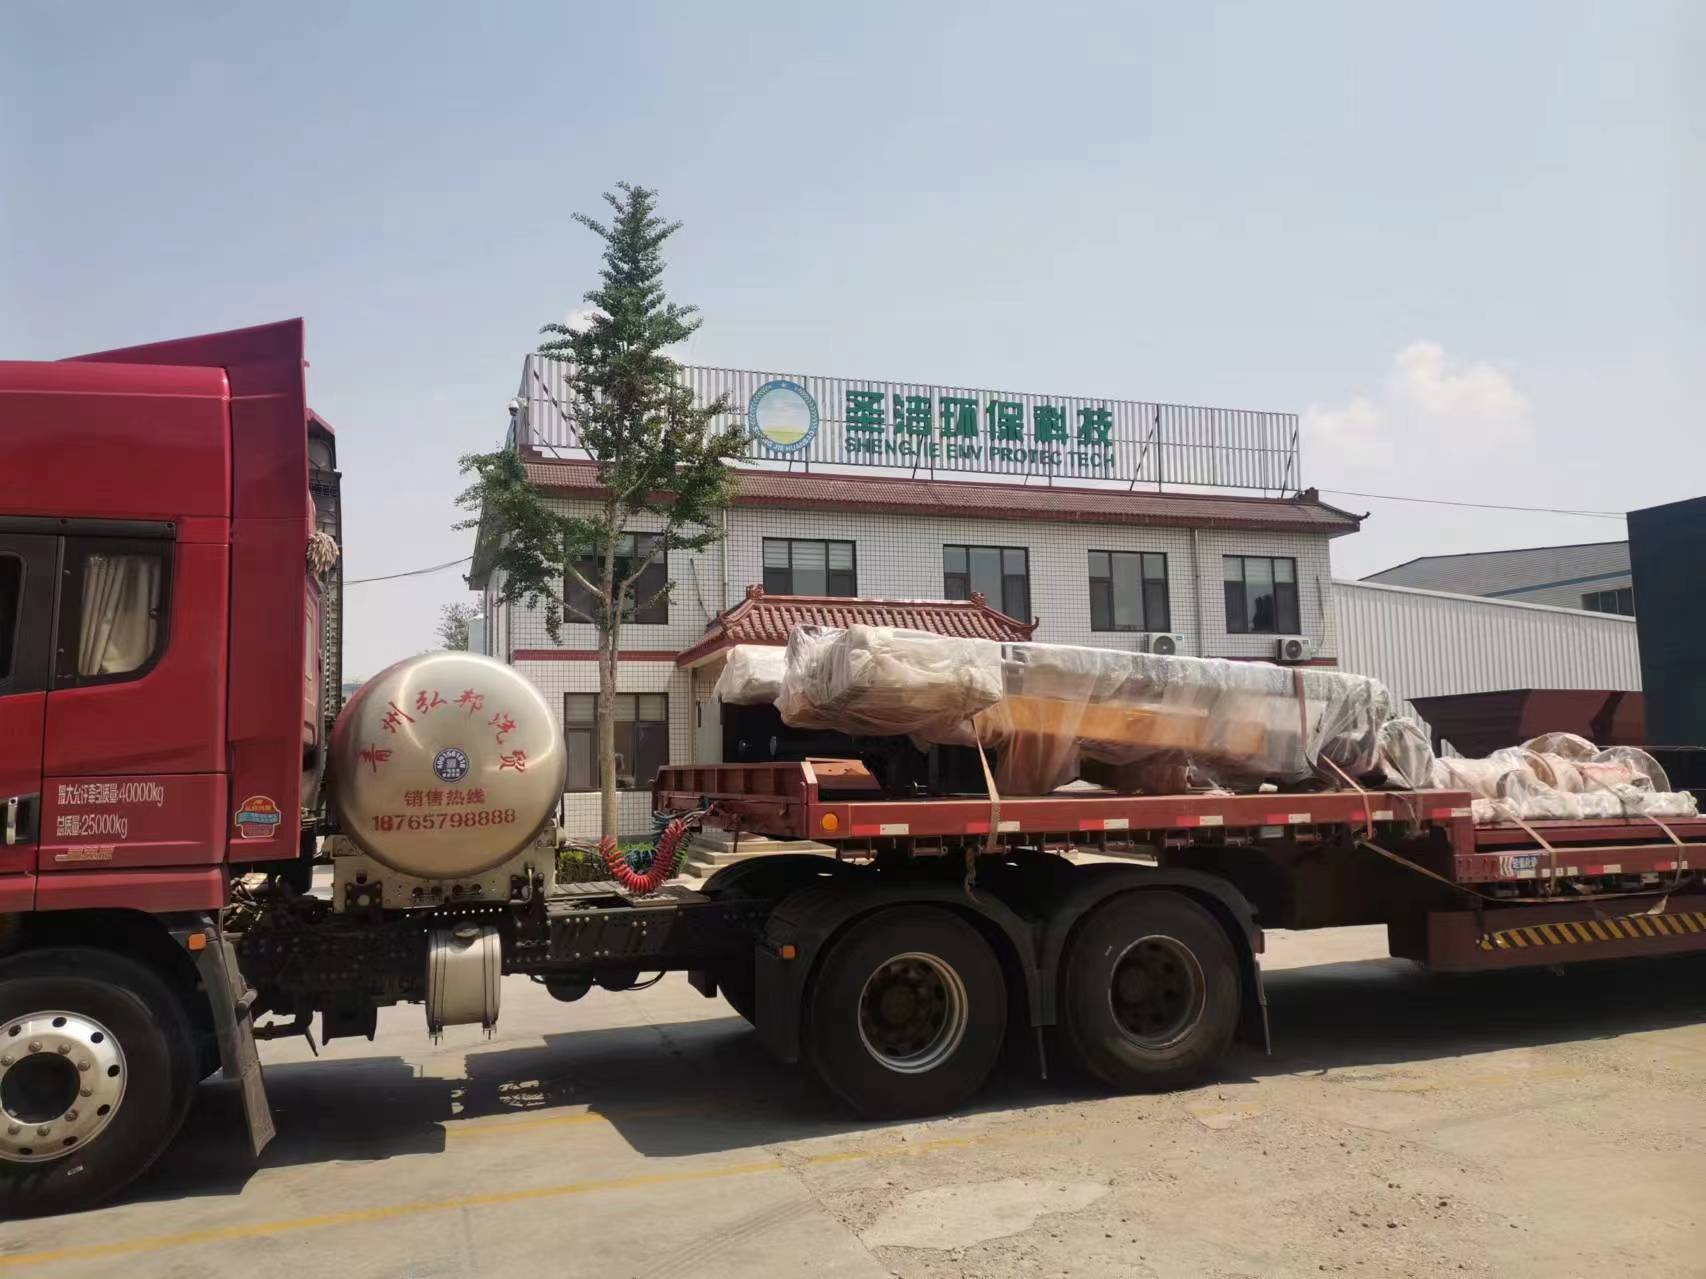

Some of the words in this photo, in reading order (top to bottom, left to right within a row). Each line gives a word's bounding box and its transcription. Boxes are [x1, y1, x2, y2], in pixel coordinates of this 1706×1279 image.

[946, 442, 983, 461] ENV
[989, 445, 1063, 466] PROTEC
[1067, 451, 1115, 468] TECH
[404, 788, 487, 808] 销售热线
[372, 808, 516, 832] 18765798888
